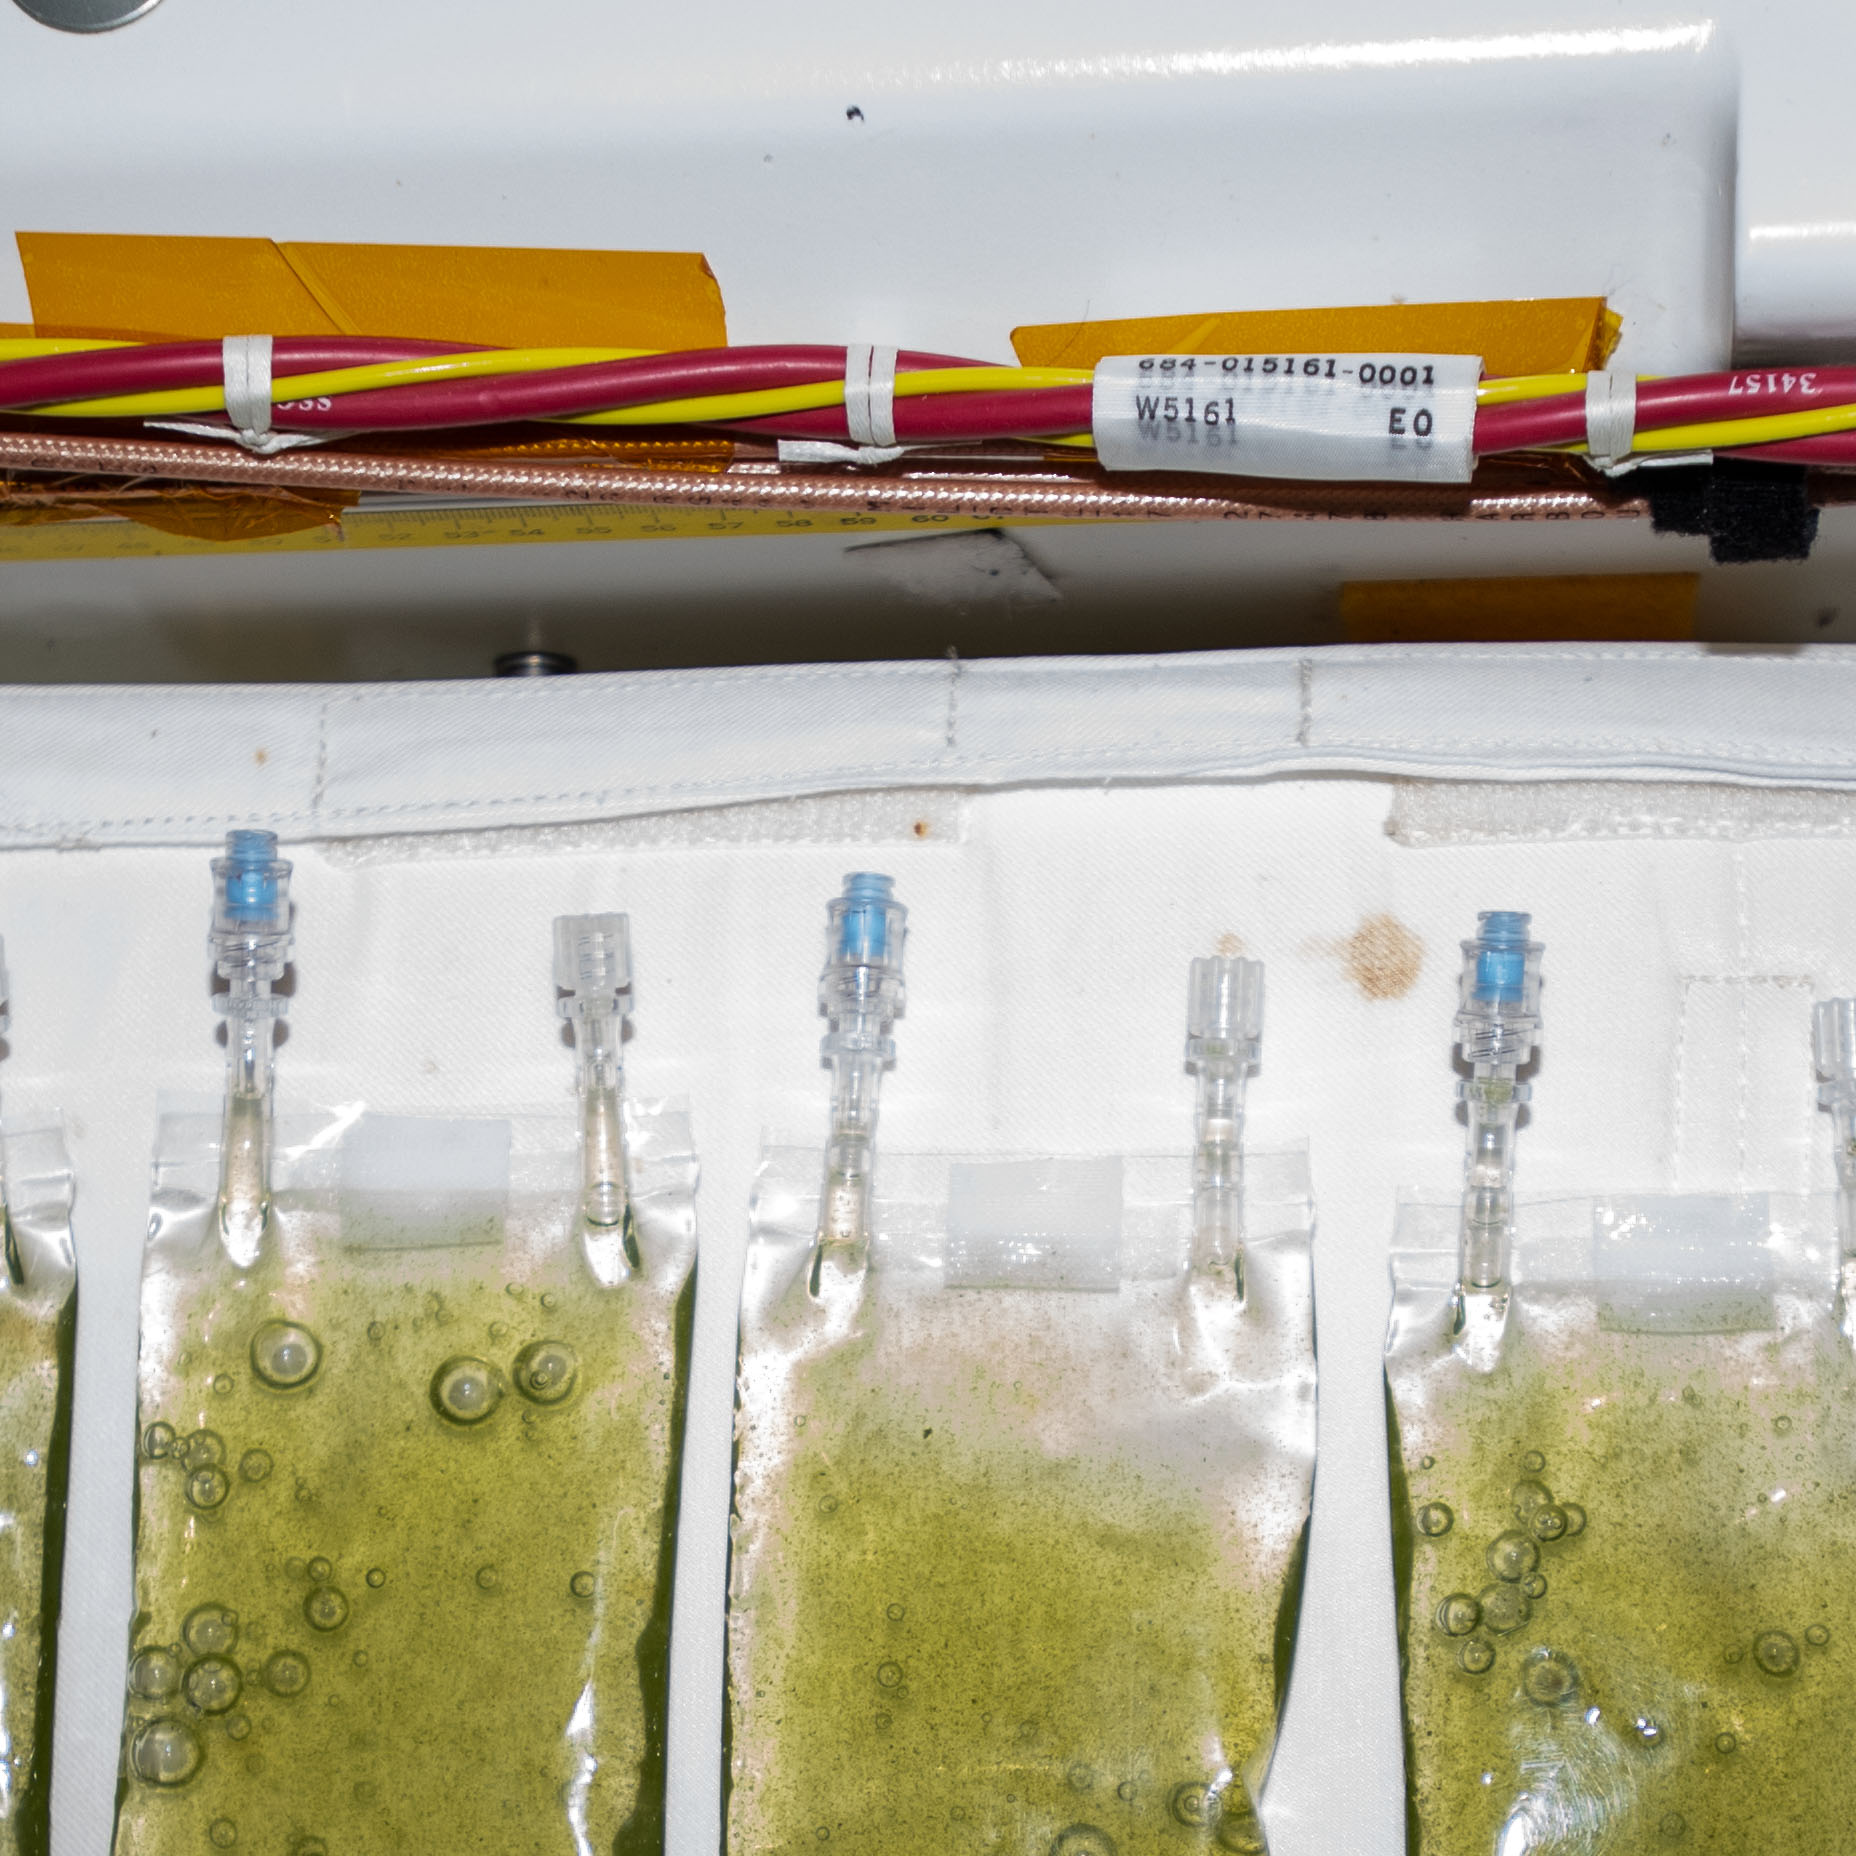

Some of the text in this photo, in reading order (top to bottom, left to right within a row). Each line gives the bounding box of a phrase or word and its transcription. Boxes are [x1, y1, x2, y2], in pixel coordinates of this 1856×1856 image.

[1728, 371, 1818, 396] 34157
[1136, 396, 1236, 427] W5161
[510, 527, 544, 538] 54
[708, 520, 744, 531] 57
[776, 518, 813, 528] 58
[839, 516, 878, 527] 59
[912, 513, 950, 523] 60
